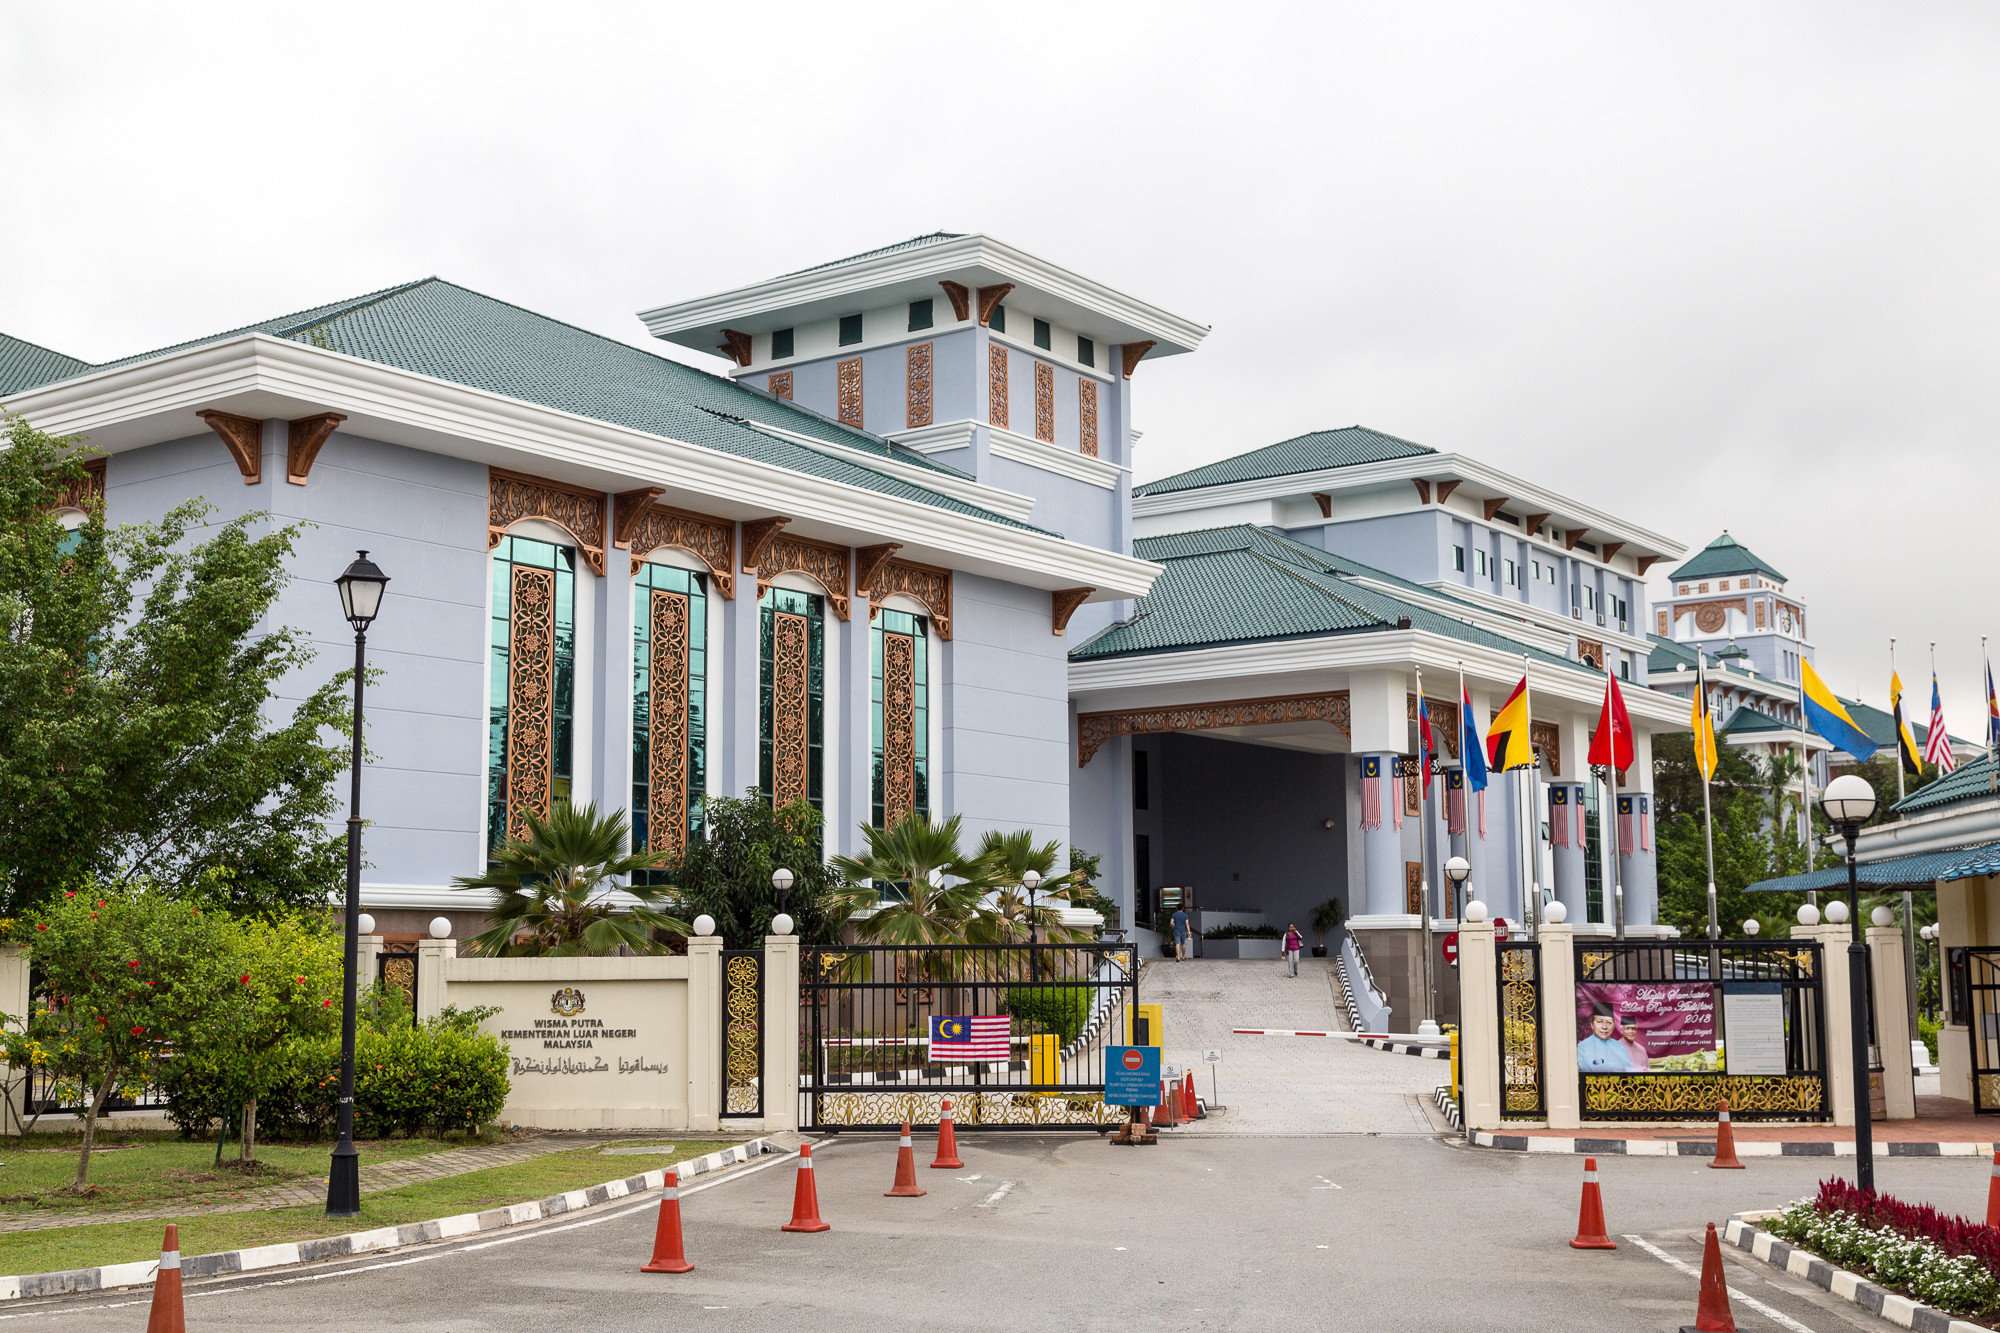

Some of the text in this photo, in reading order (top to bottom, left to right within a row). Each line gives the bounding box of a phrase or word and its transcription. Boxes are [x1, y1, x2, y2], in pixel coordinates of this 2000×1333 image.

[1667, 988, 1710, 1001] Sambutan
[1620, 1000, 1644, 1012] Hari
[1646, 1001, 1672, 1016] Raya
[534, 1018, 604, 1028] WISMA PUTRA
[1684, 1013, 1711, 1024] 2013
[501, 1029, 637, 1039] KEMENTERIAN LUAR NEGERI
[543, 1039, 593, 1049] MALAYSIA
